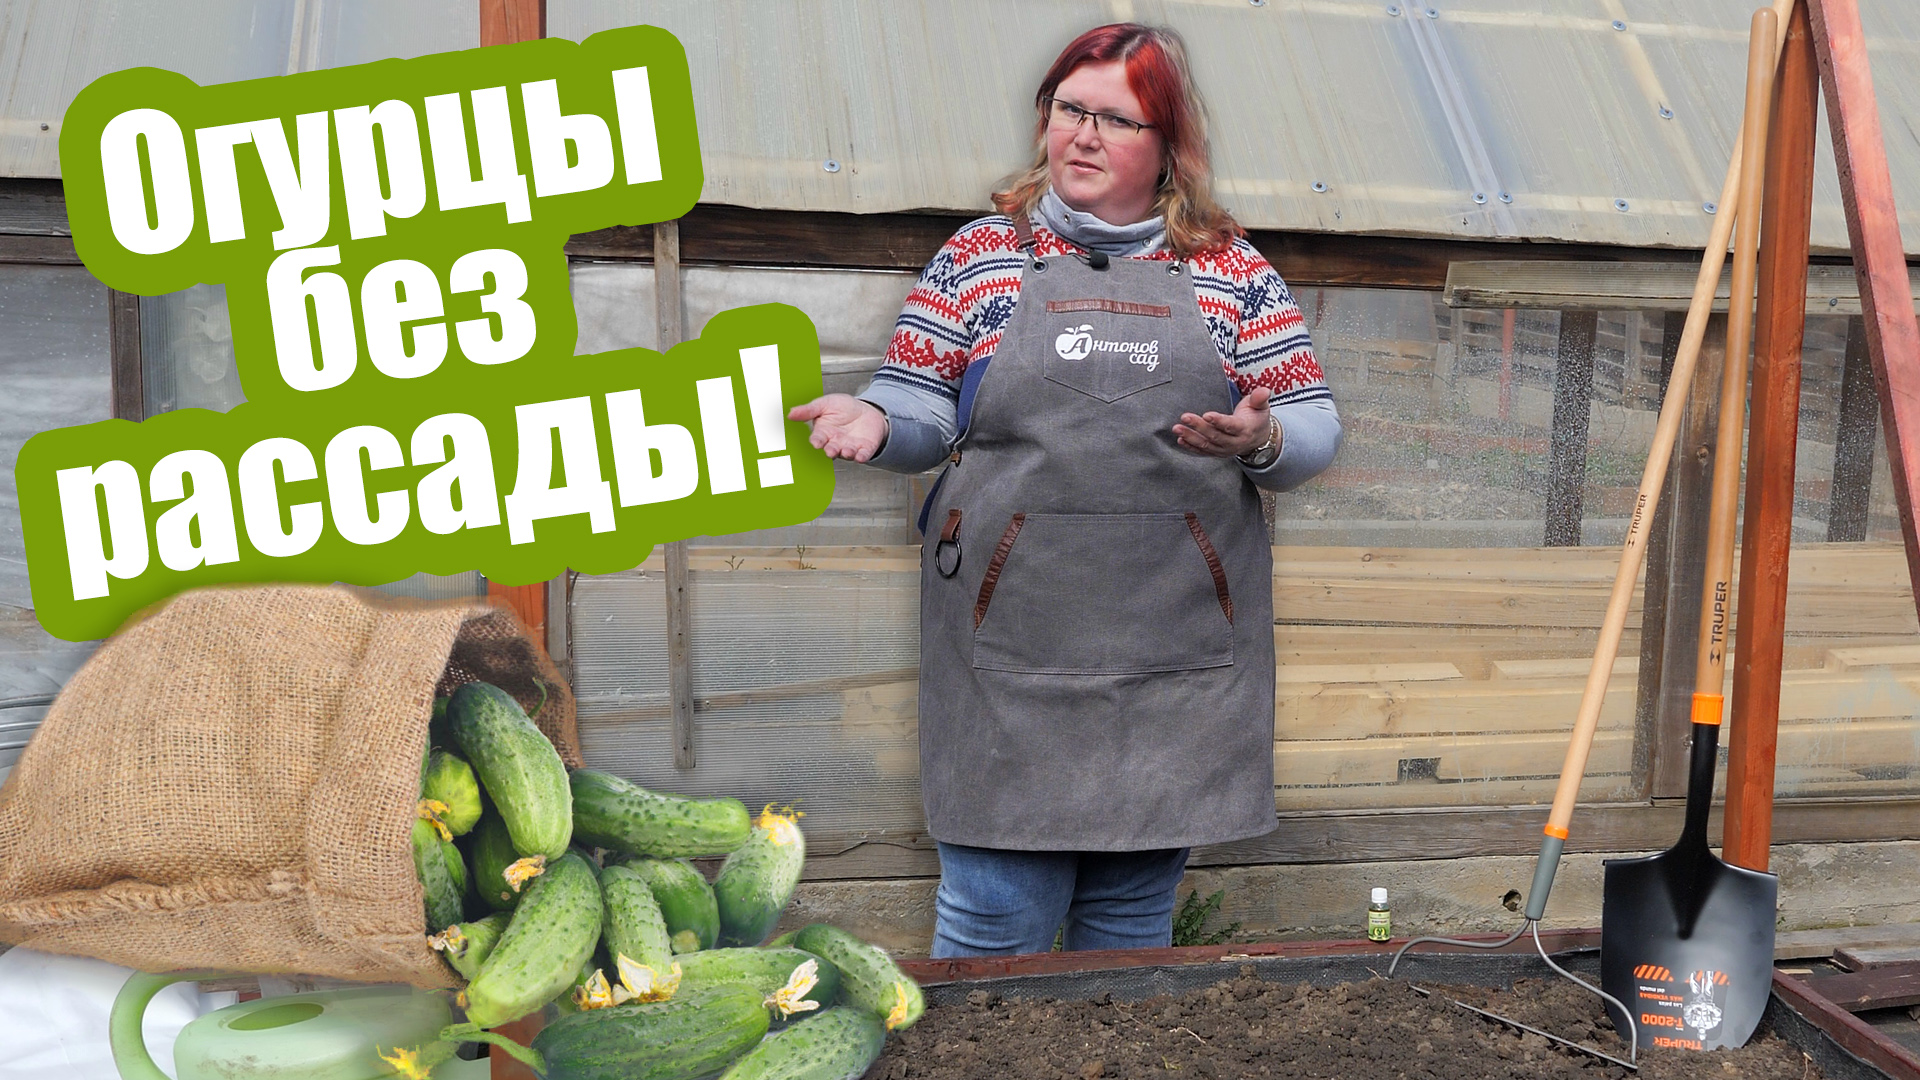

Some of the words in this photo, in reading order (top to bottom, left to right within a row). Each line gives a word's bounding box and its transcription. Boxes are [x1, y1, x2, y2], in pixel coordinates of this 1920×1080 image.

[1059, 335, 1159, 356] Антонов
[1129, 353, 1160, 372] сад
[1630, 494, 1648, 535] TRUPER
[1711, 581, 1727, 645] TRUPER
[1641, 1013, 1684, 1027] T-2000
[1654, 1037, 1703, 1050] TRUPER
